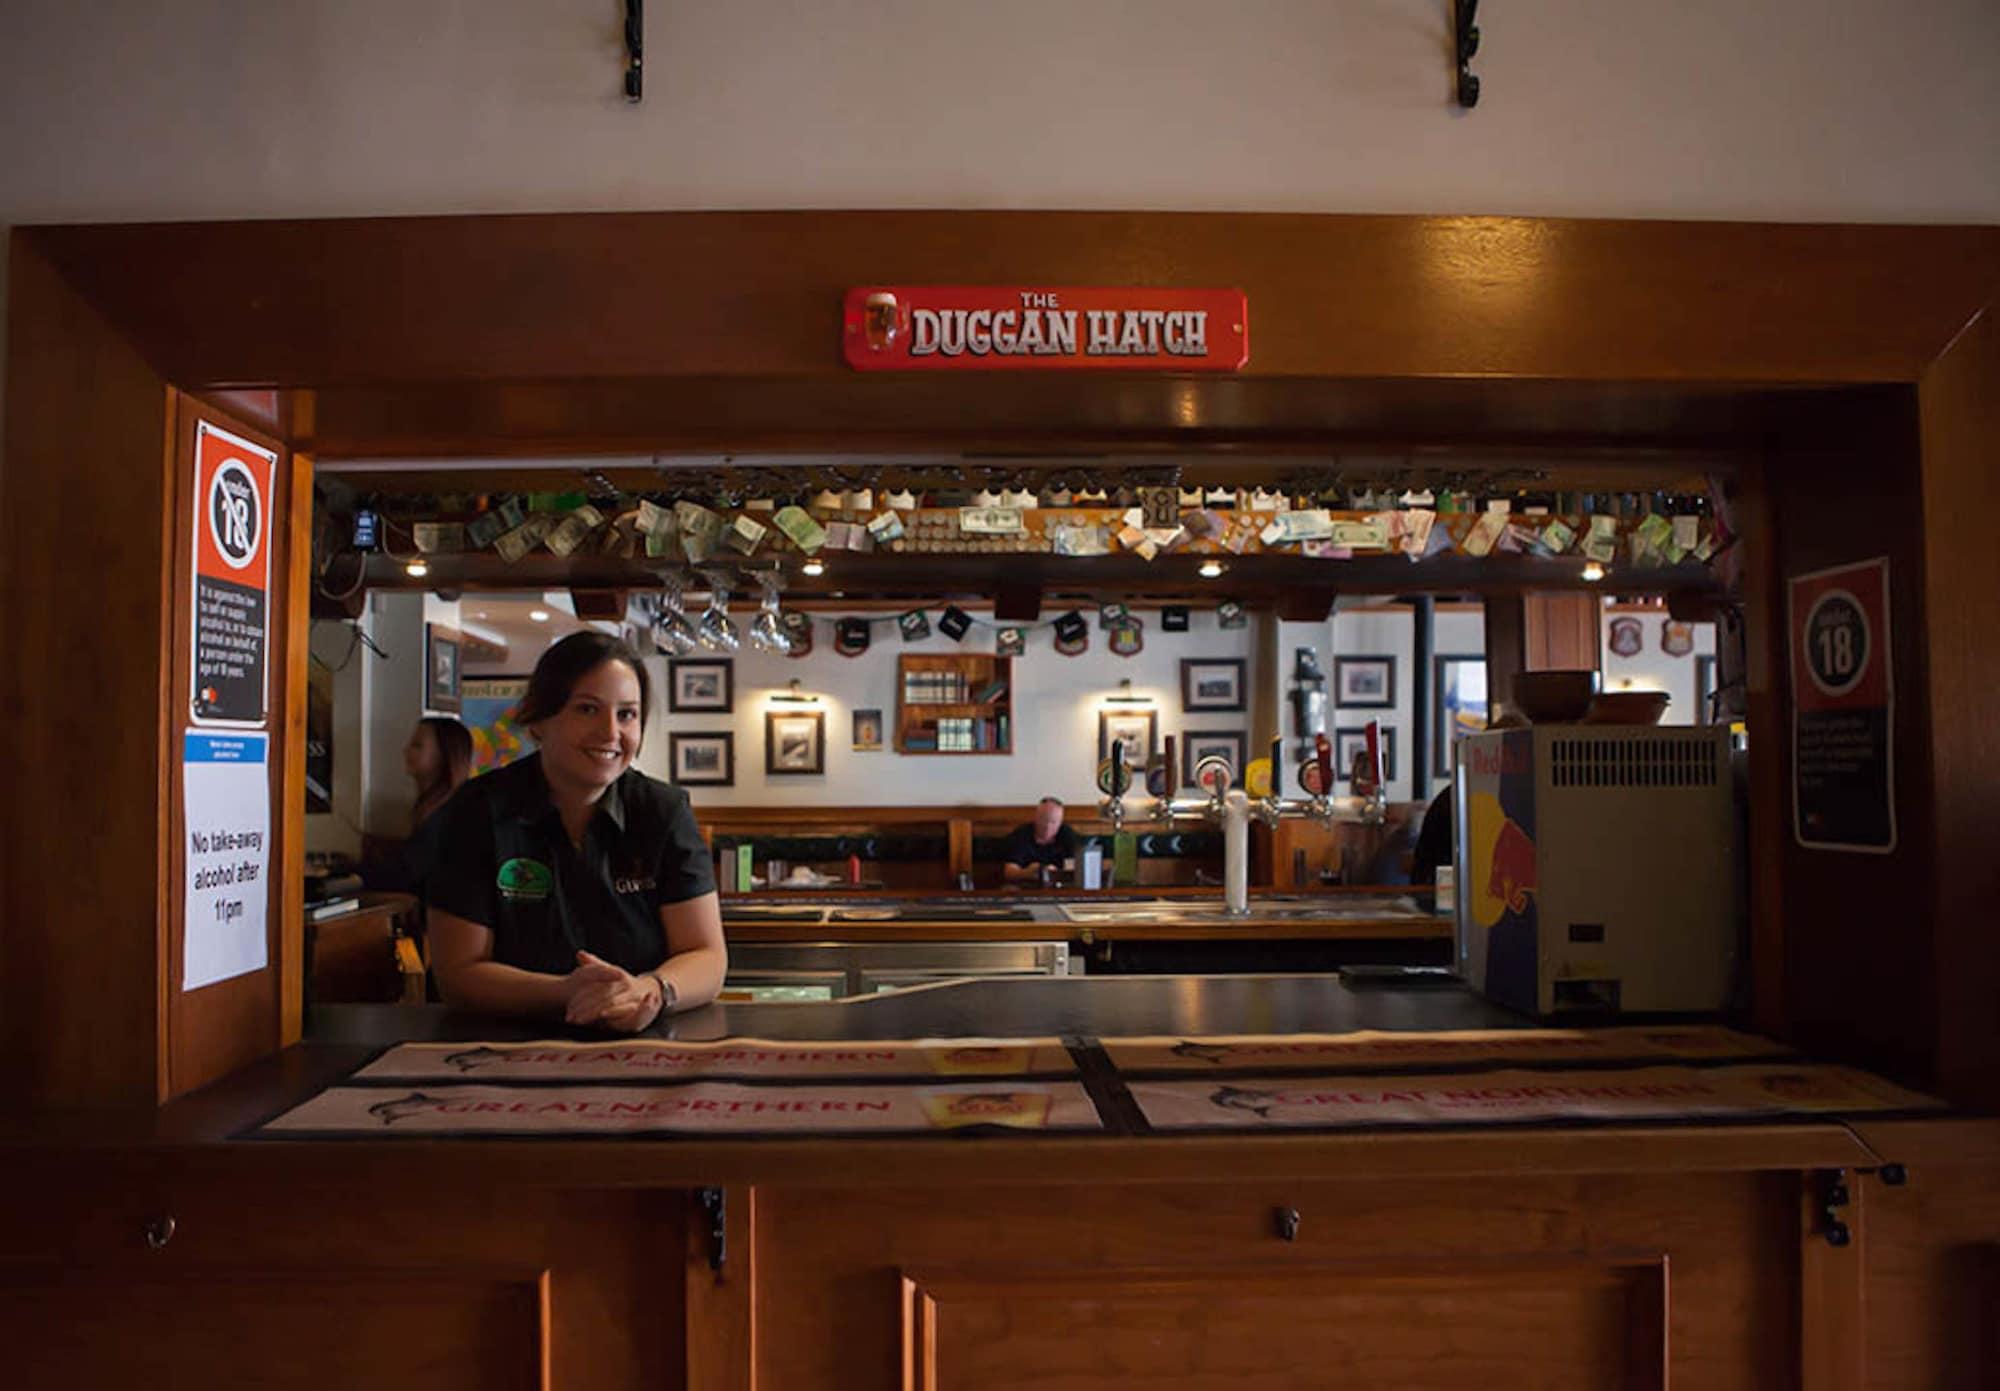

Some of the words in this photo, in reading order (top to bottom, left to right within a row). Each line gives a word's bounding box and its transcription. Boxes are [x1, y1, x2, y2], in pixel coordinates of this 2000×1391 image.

[1020, 292, 1060, 308] THE
[910, 309, 1078, 356] DUGGAN
[1086, 310, 1209, 356] HATCH
[222, 499, 249, 549] 18
[1818, 625, 1853, 675] 18
[192, 831, 208, 854] No
[211, 830, 263, 852] take-away
[195, 862, 235, 890] alcohol
[237, 860, 260, 882] after
[215, 898, 242, 924] 11pm
[436, 1102, 597, 1114] GREAT
[608, 1101, 890, 1113] NORTHERN
